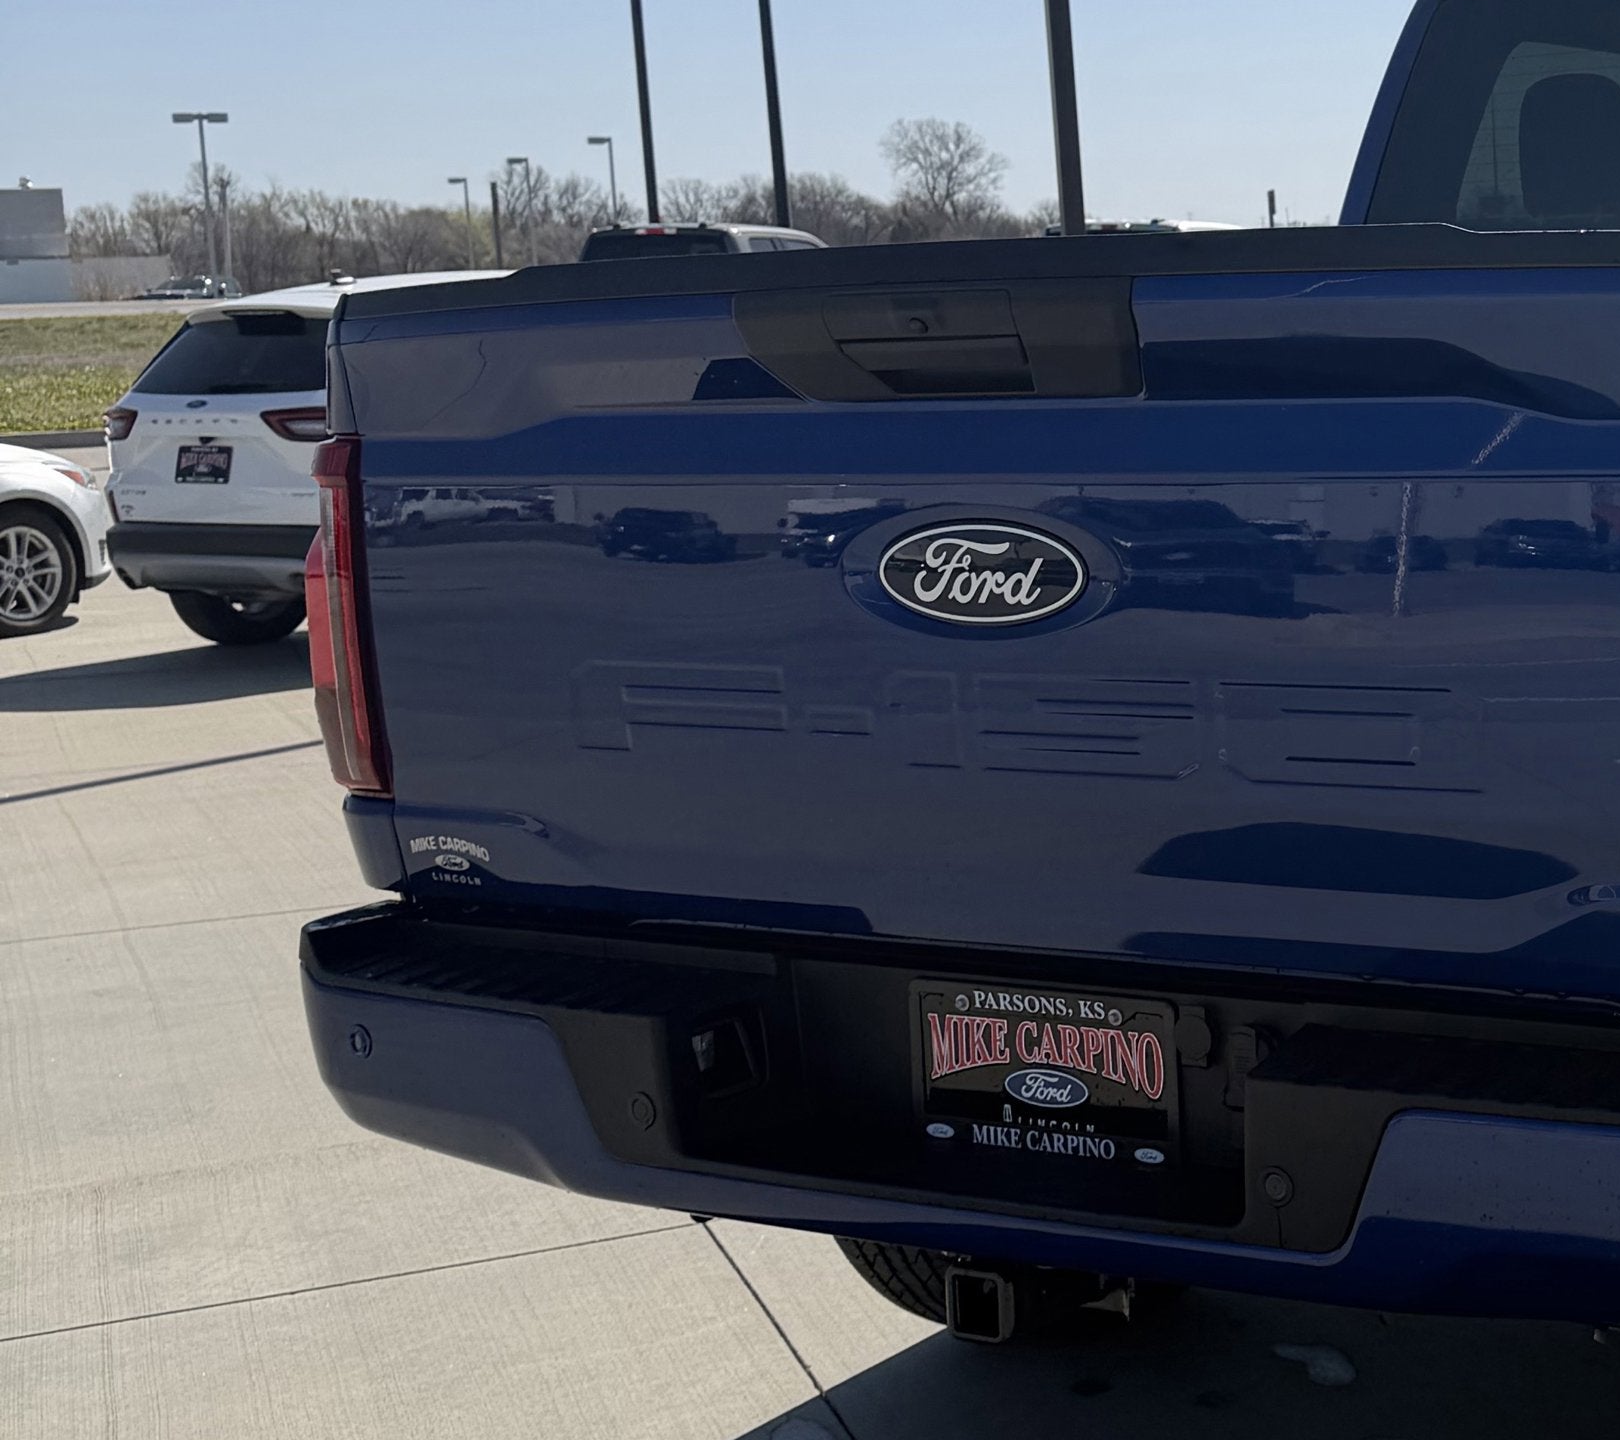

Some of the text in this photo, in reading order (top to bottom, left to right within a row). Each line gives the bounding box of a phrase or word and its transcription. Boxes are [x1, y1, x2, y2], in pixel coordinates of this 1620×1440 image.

[913, 537, 1045, 606] Ford
[571, 658, 1486, 794] F-150
[410, 835, 490, 862] MIKE CARPINO
[432, 871, 482, 886] LINCOLN
[973, 990, 1106, 1020] PARSONS, KS
[928, 1013, 1164, 1100] MIKE CARPINO
[1020, 1072, 1073, 1104] Ford
[973, 1124, 1116, 1160] MIKE CARPINO
